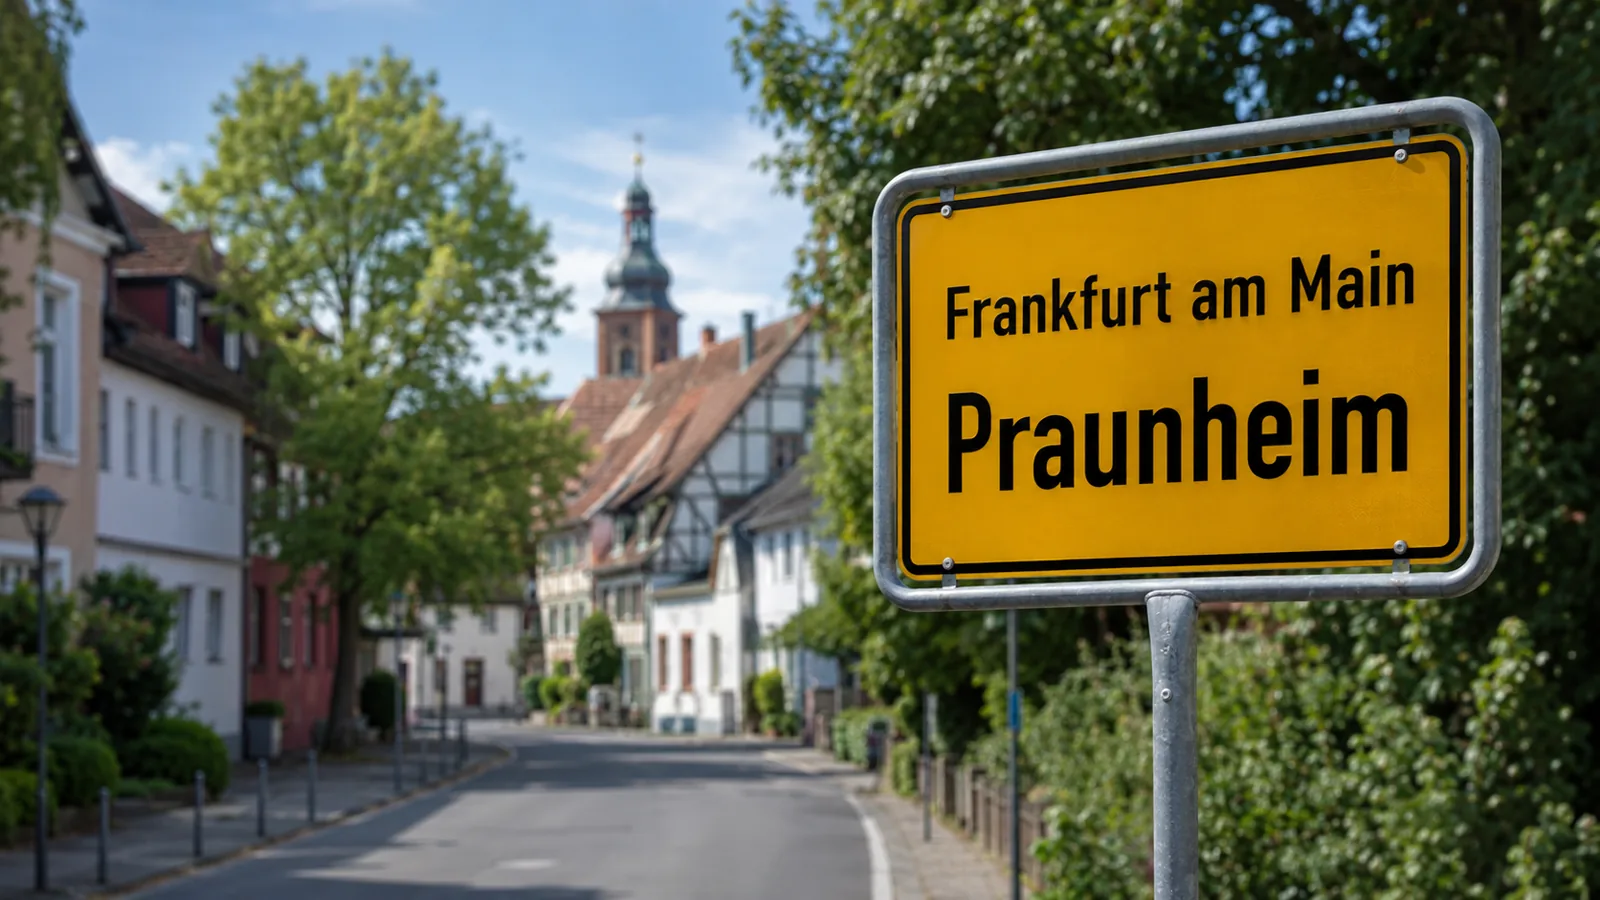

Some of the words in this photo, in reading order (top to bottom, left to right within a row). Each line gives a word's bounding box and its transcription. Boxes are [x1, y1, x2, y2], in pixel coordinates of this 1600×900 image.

[946, 271, 1172, 341] Frankfurt
[1191, 275, 1266, 321] am
[1291, 249, 1415, 314] Main
[948, 368, 1408, 494] Praunheim
